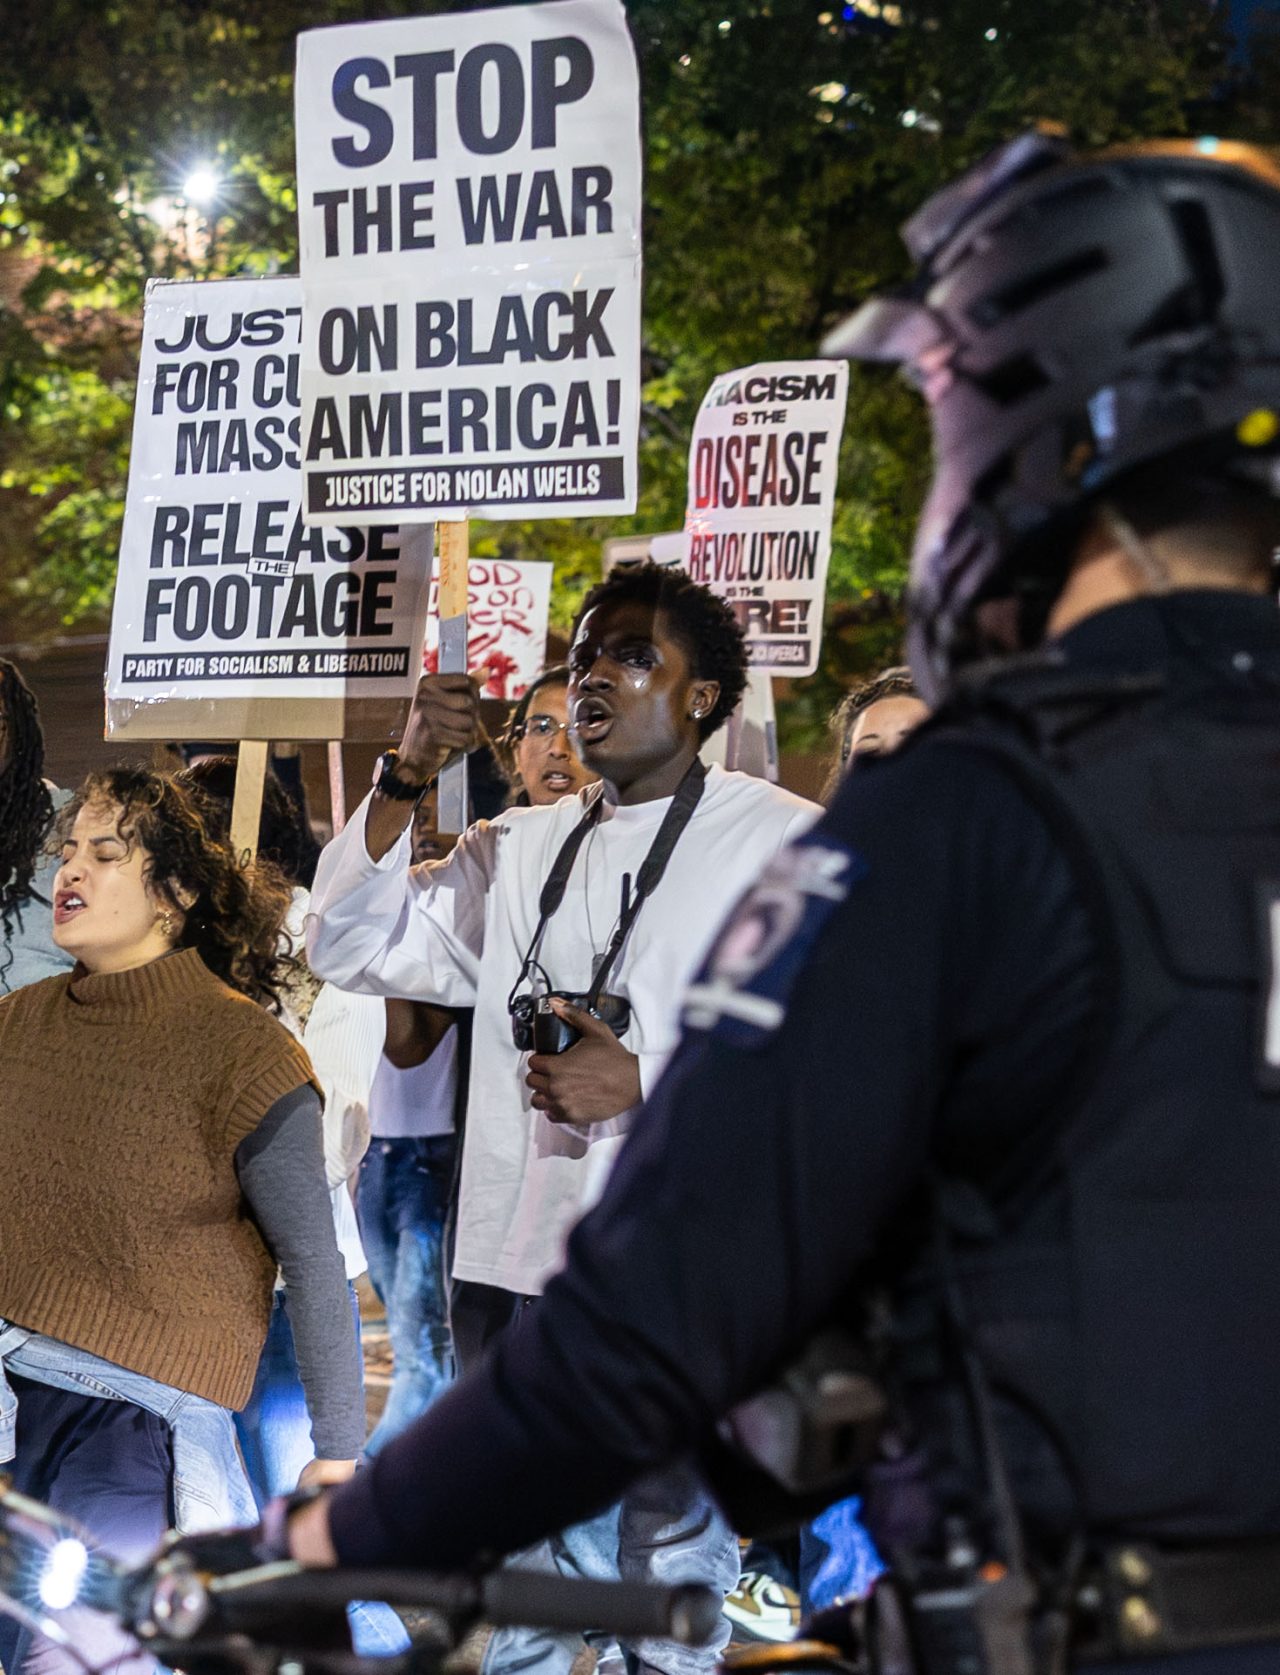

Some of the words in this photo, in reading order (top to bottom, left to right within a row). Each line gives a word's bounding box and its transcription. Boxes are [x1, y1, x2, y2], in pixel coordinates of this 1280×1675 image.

[332, 35, 595, 168] STOP
[313, 180, 435, 257] THE
[456, 165, 613, 246] WAR
[154, 307, 302, 353] JUST
[318, 304, 397, 375] ON
[416, 287, 615, 369] BLACK
[152, 358, 239, 415] FOR
[175, 416, 301, 475] MASS
[306, 379, 621, 461] AMERICA!
[733, 411, 748, 426] IS
[752, 409, 787, 424] THE
[325, 472, 407, 507] JUSTICE
[410, 471, 451, 502] FOR
[456, 467, 529, 500] NOLAN
[532, 464, 601, 497] WELLS
[695, 431, 829, 509] DISEASE
[149, 500, 401, 569] RELEASE
[690, 530, 820, 583] REVOLUTION
[254, 561, 290, 575] THE
[143, 570, 397, 642] FOOTAGE
[731, 599, 812, 634] RE!
[125, 657, 173, 679] PARTY
[176, 657, 205, 676] FOR
[208, 654, 293, 675] SOCIALISM
[297, 655, 310, 673] &
[314, 652, 405, 674] LIBERATION
